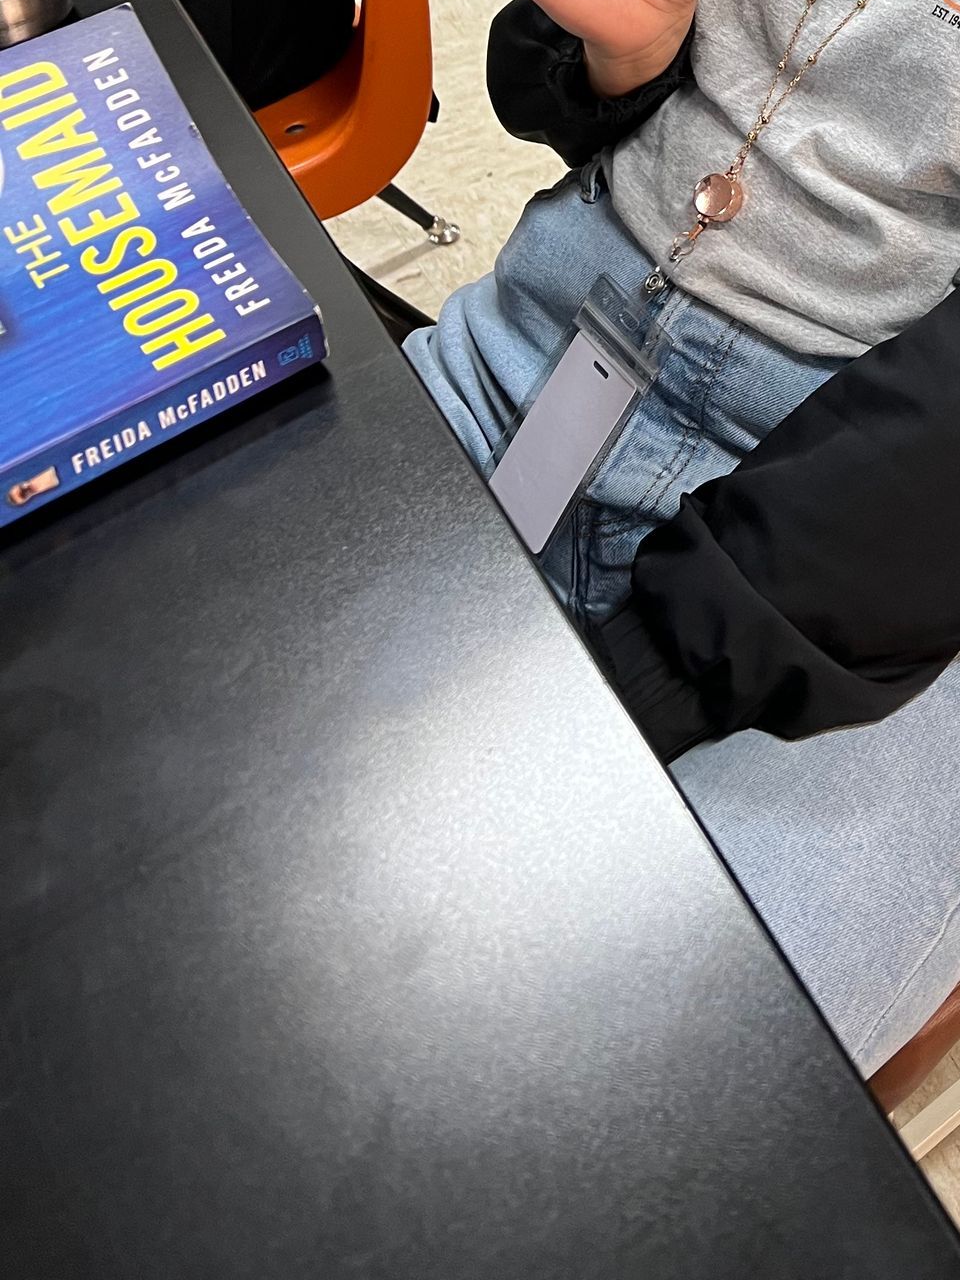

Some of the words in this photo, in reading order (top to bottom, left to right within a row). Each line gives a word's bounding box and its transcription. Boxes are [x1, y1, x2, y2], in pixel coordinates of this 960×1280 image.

[0, 60, 227, 372] HOUSEMAID
[4, 213, 70, 290] THE
[181, 215, 271, 318] FREIDA
[71, 421, 153, 474] FREIDA
